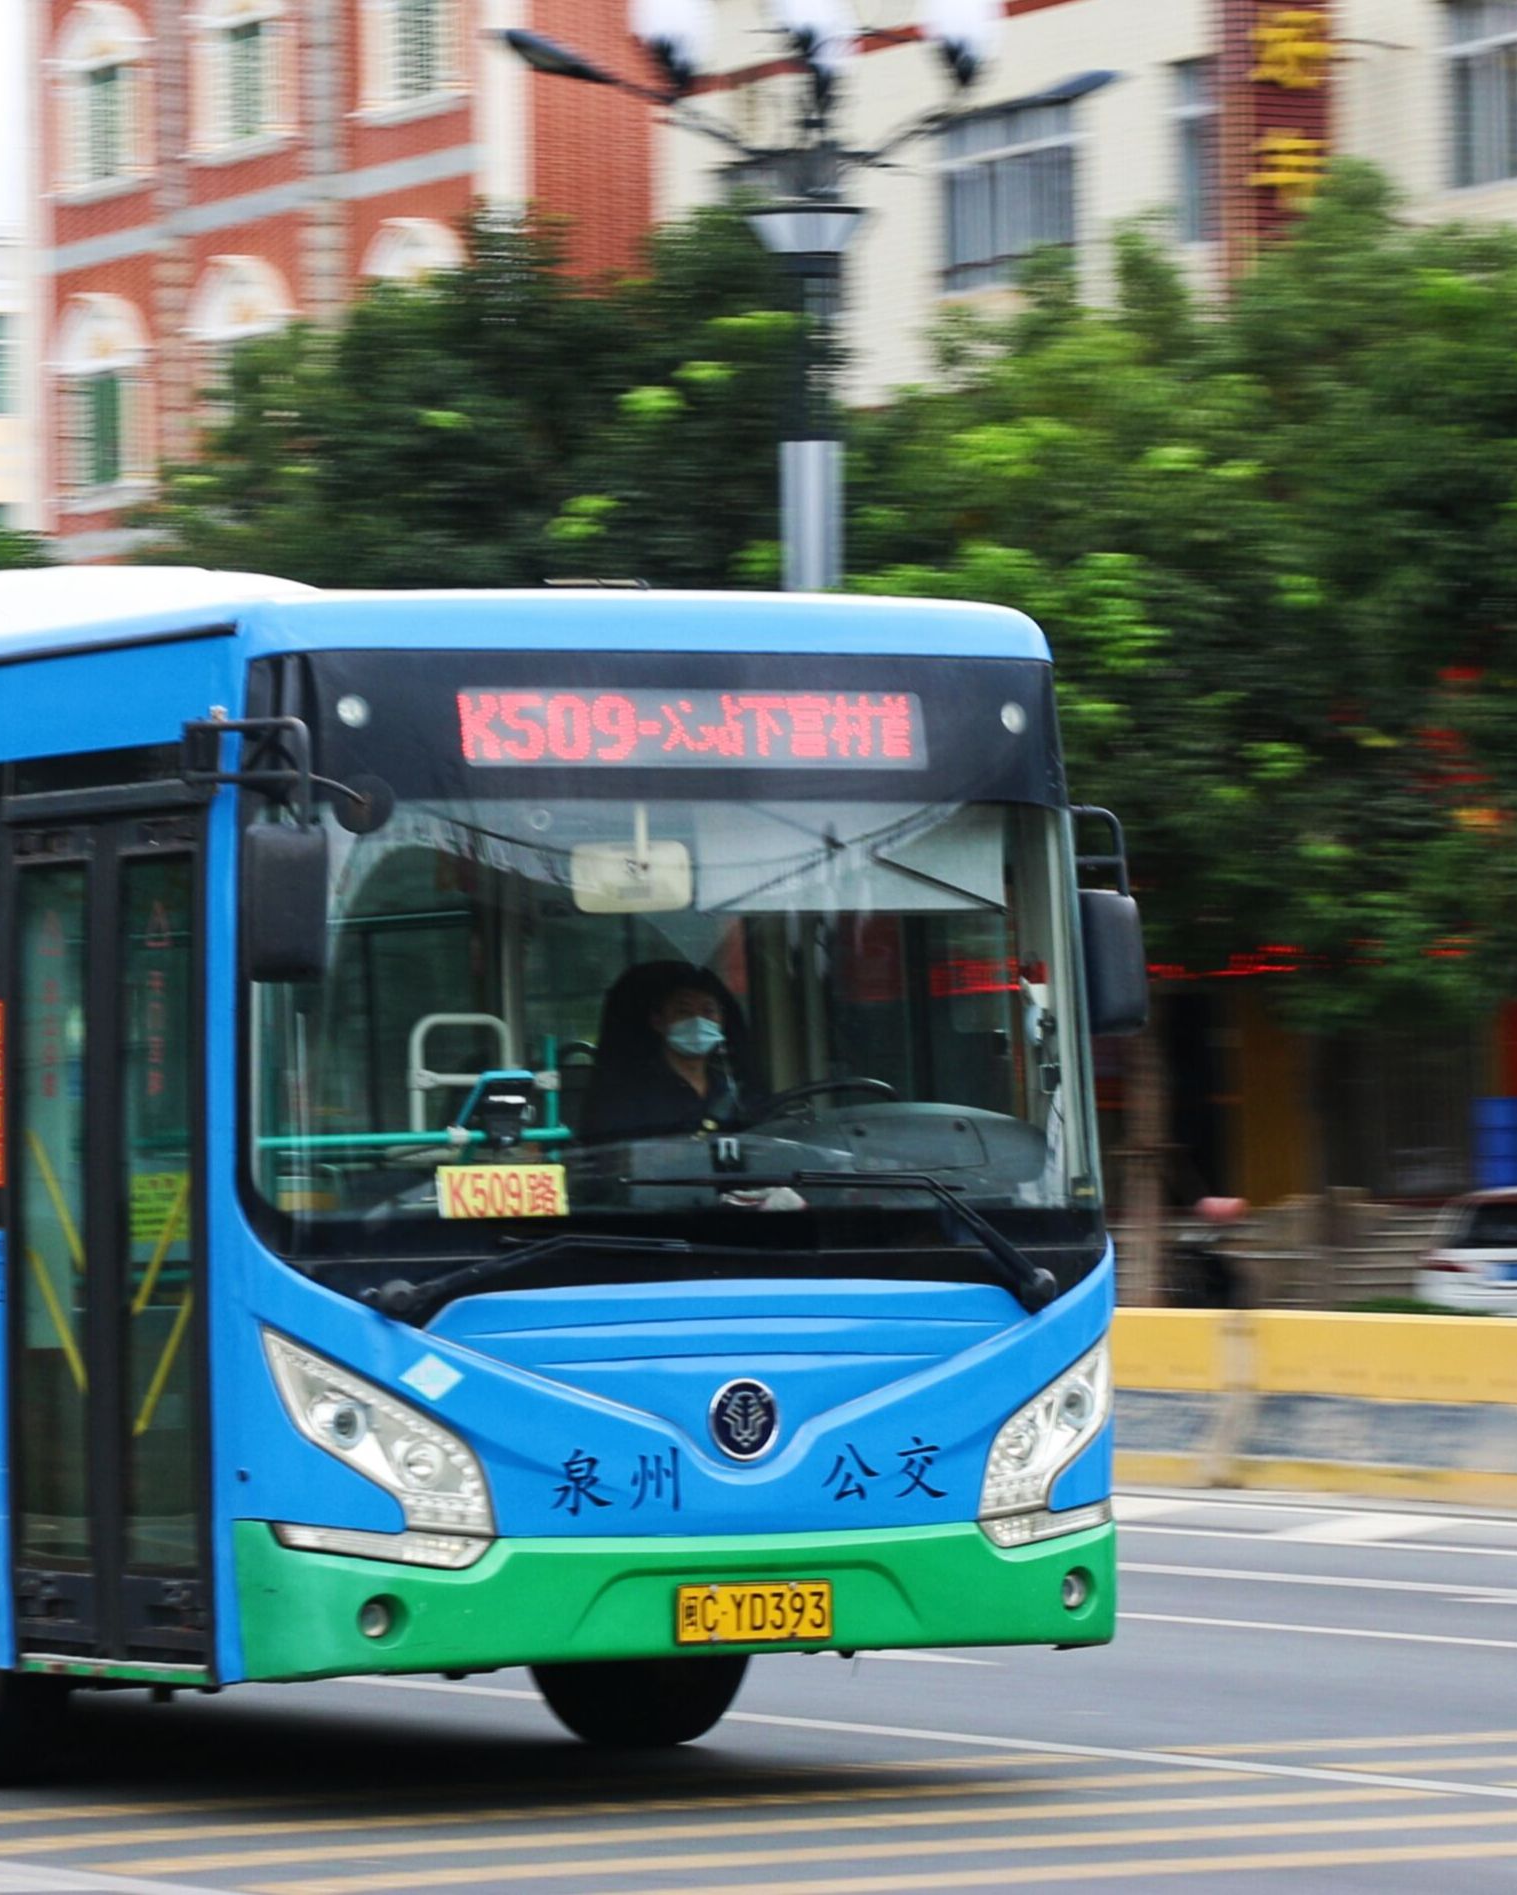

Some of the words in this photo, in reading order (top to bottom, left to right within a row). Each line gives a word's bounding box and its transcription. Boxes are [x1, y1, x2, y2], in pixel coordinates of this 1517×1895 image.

[446, 1172, 559, 1218] K509路
[550, 1446, 681, 1516] 泉州
[821, 1436, 947, 1501] 公交
